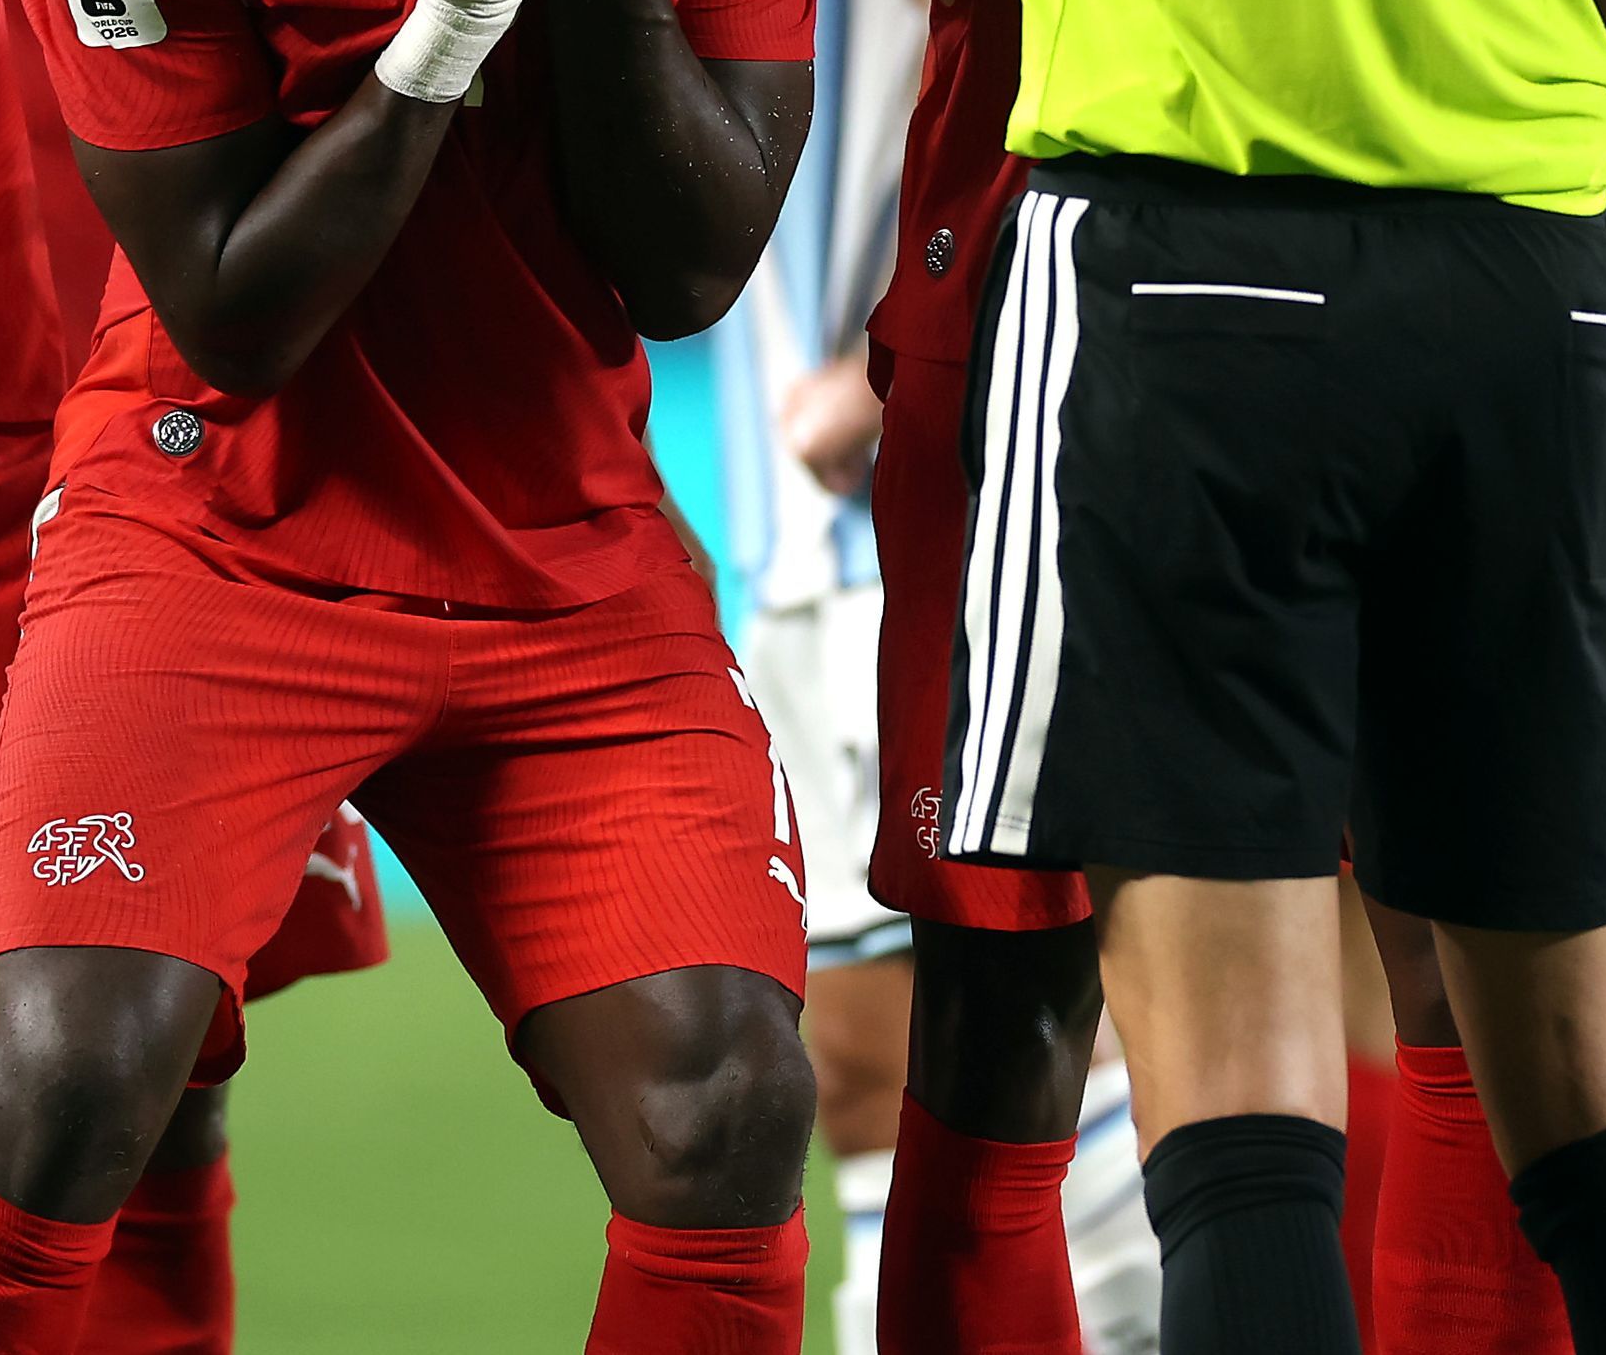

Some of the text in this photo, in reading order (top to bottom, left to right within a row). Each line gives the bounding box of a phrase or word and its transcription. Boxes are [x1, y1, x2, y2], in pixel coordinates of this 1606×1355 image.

[95, 1, 117, 11] FIFA
[92, 20, 117, 29] ORLD
[99, 26, 139, 40] 026
